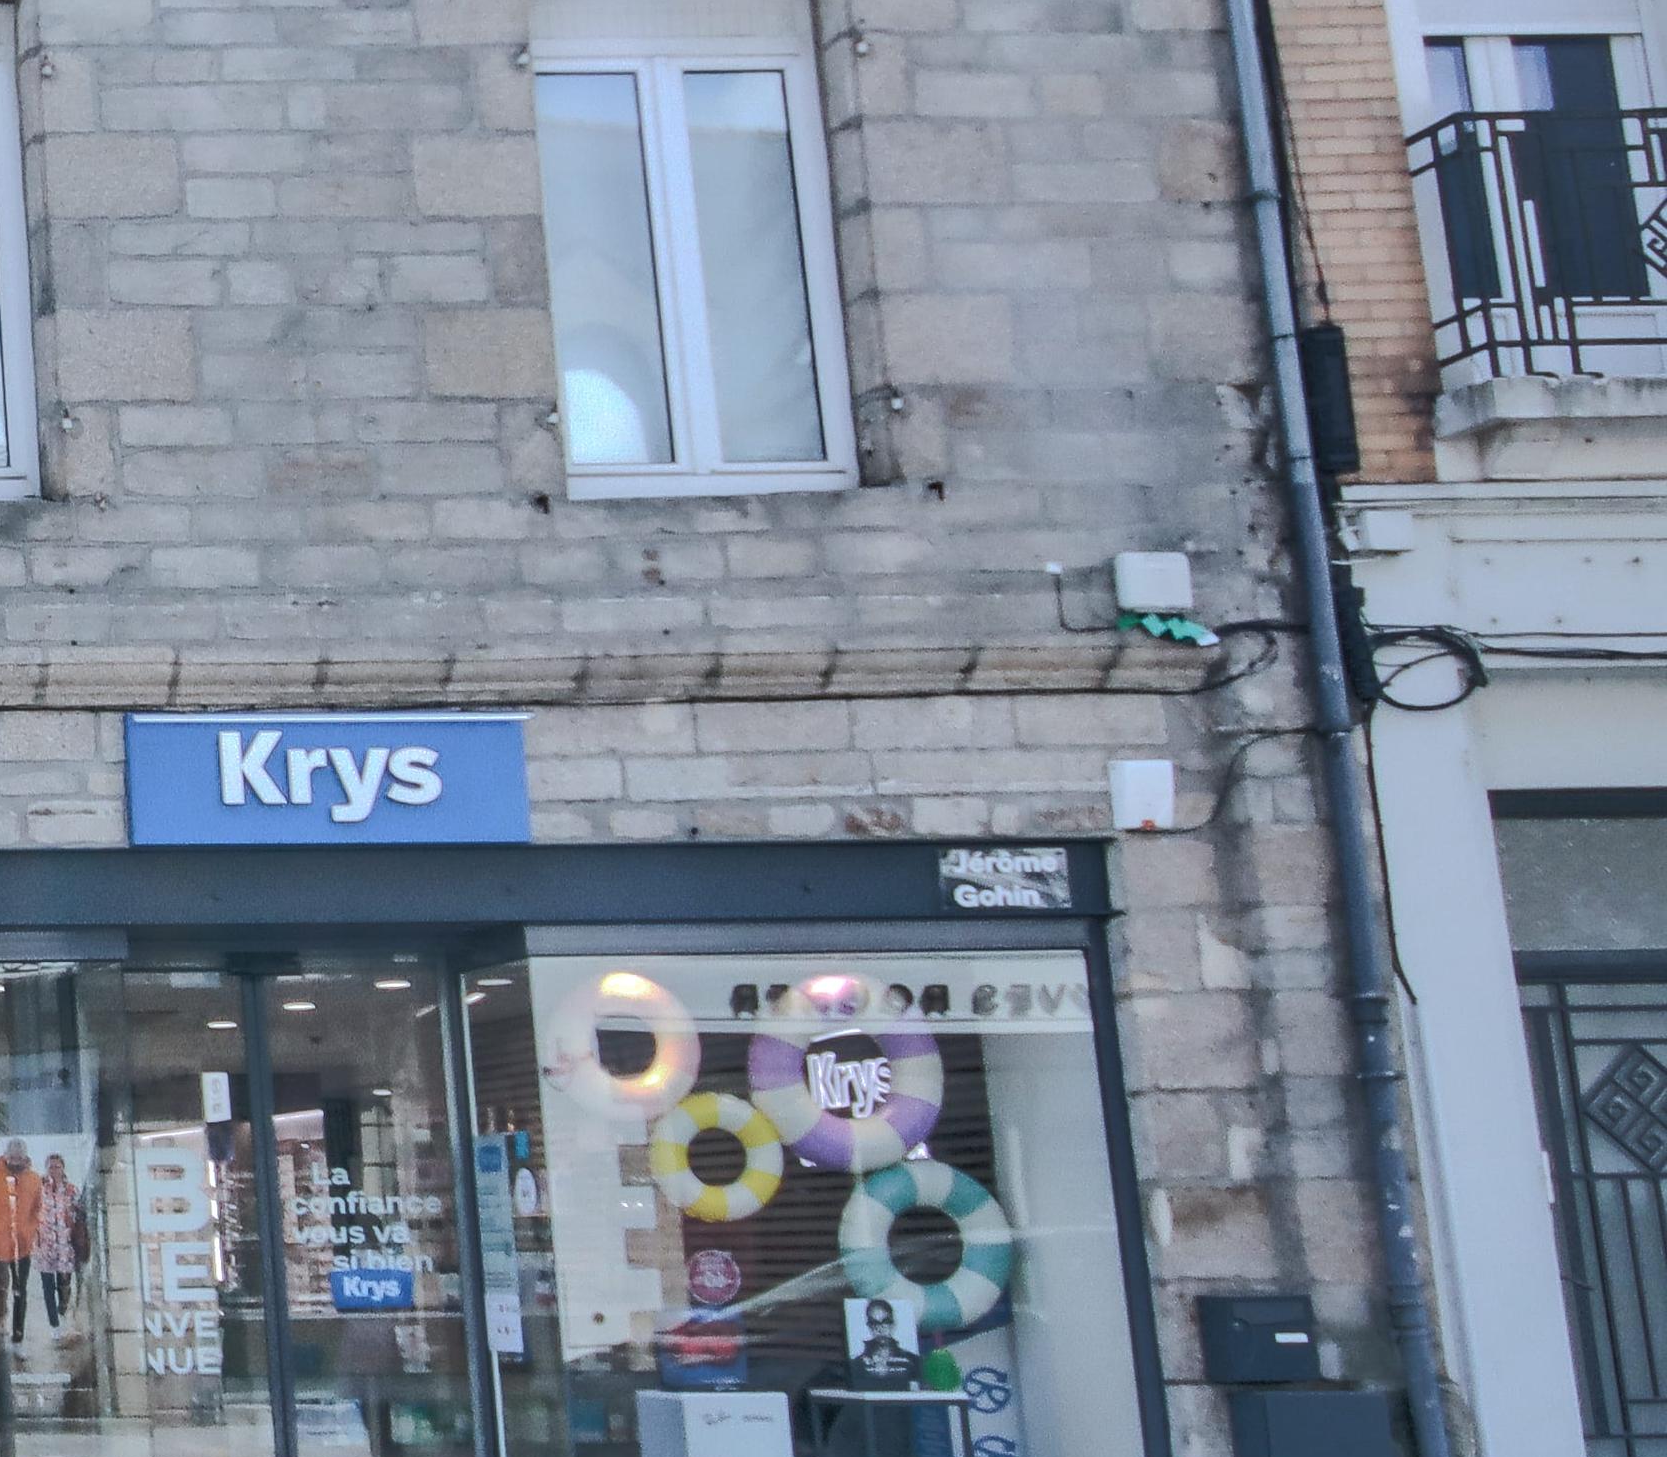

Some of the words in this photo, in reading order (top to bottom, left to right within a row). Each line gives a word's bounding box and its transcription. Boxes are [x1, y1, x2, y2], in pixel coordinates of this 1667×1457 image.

[218, 730, 444, 824] Krys
[955, 847, 1060, 875] Jérôme
[953, 884, 1042, 907] Gohin
[806, 1051, 894, 1120] Krys
[312, 1161, 351, 1186] La
[291, 1191, 443, 1215] confiance
[293, 1224, 367, 1245] vous
[372, 1221, 412, 1243] va
[332, 1247, 360, 1272] si
[366, 1247, 436, 1274] bien
[342, 1276, 403, 1303] Krys
